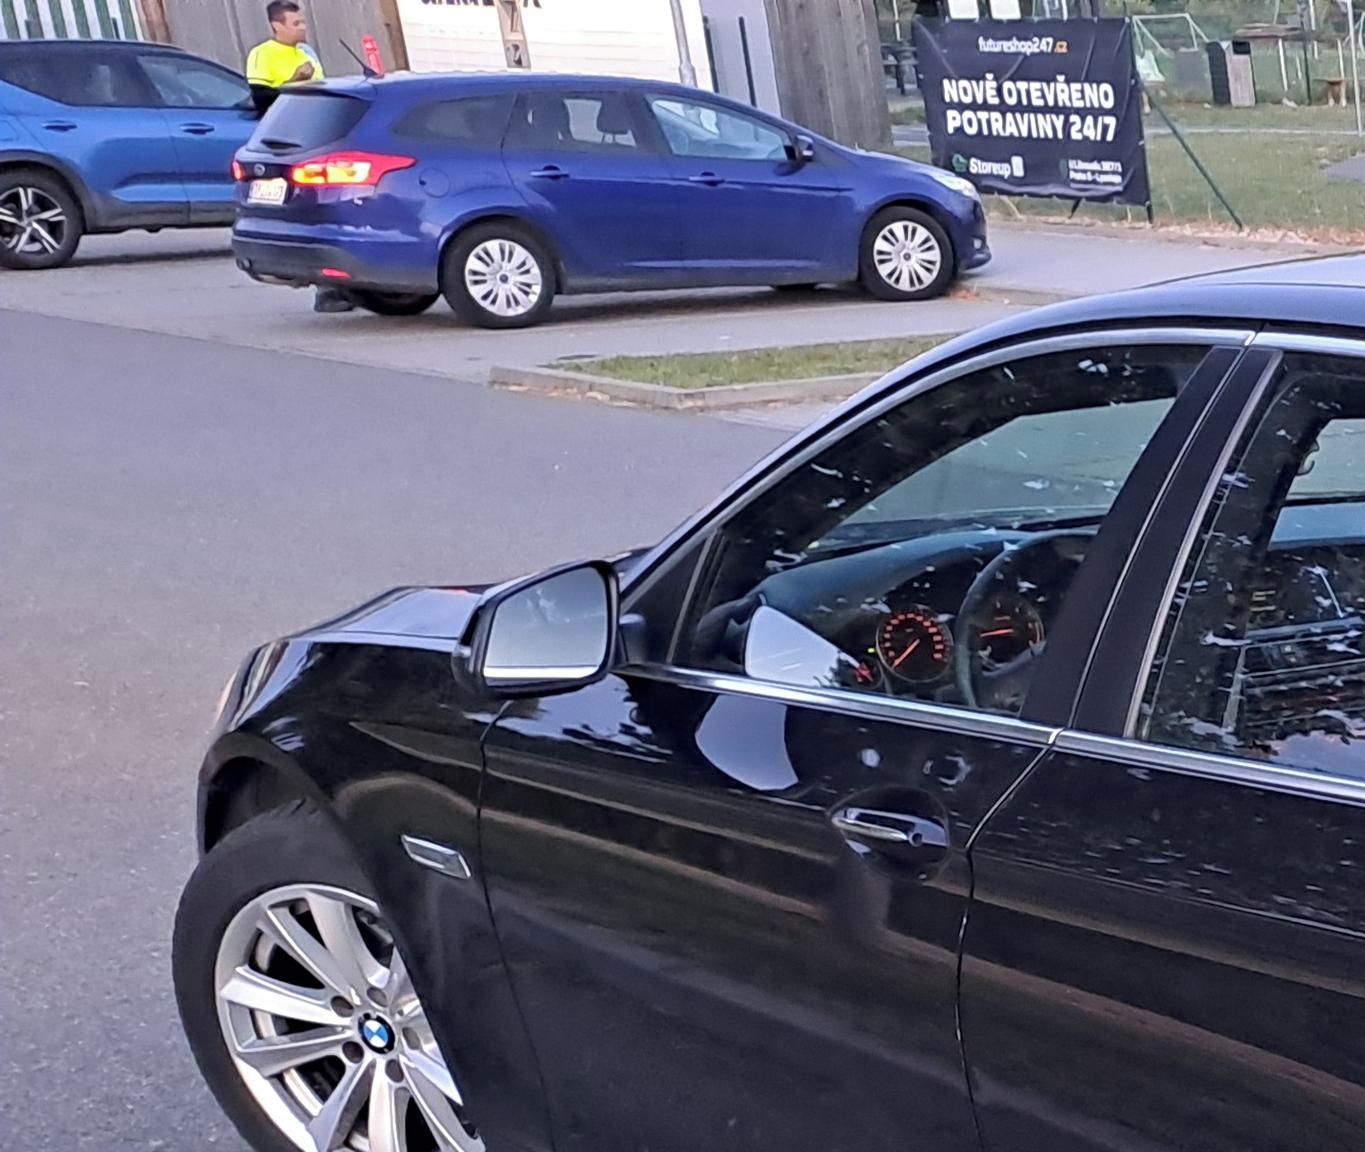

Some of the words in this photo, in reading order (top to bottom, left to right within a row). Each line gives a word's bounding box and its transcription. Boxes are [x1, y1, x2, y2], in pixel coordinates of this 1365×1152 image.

[942, 72, 1000, 105] NOVĚ
[1002, 74, 1115, 109] OTEVŘENO
[946, 109, 1065, 139] POTRAVINY
[1069, 114, 1117, 142] 24/7
